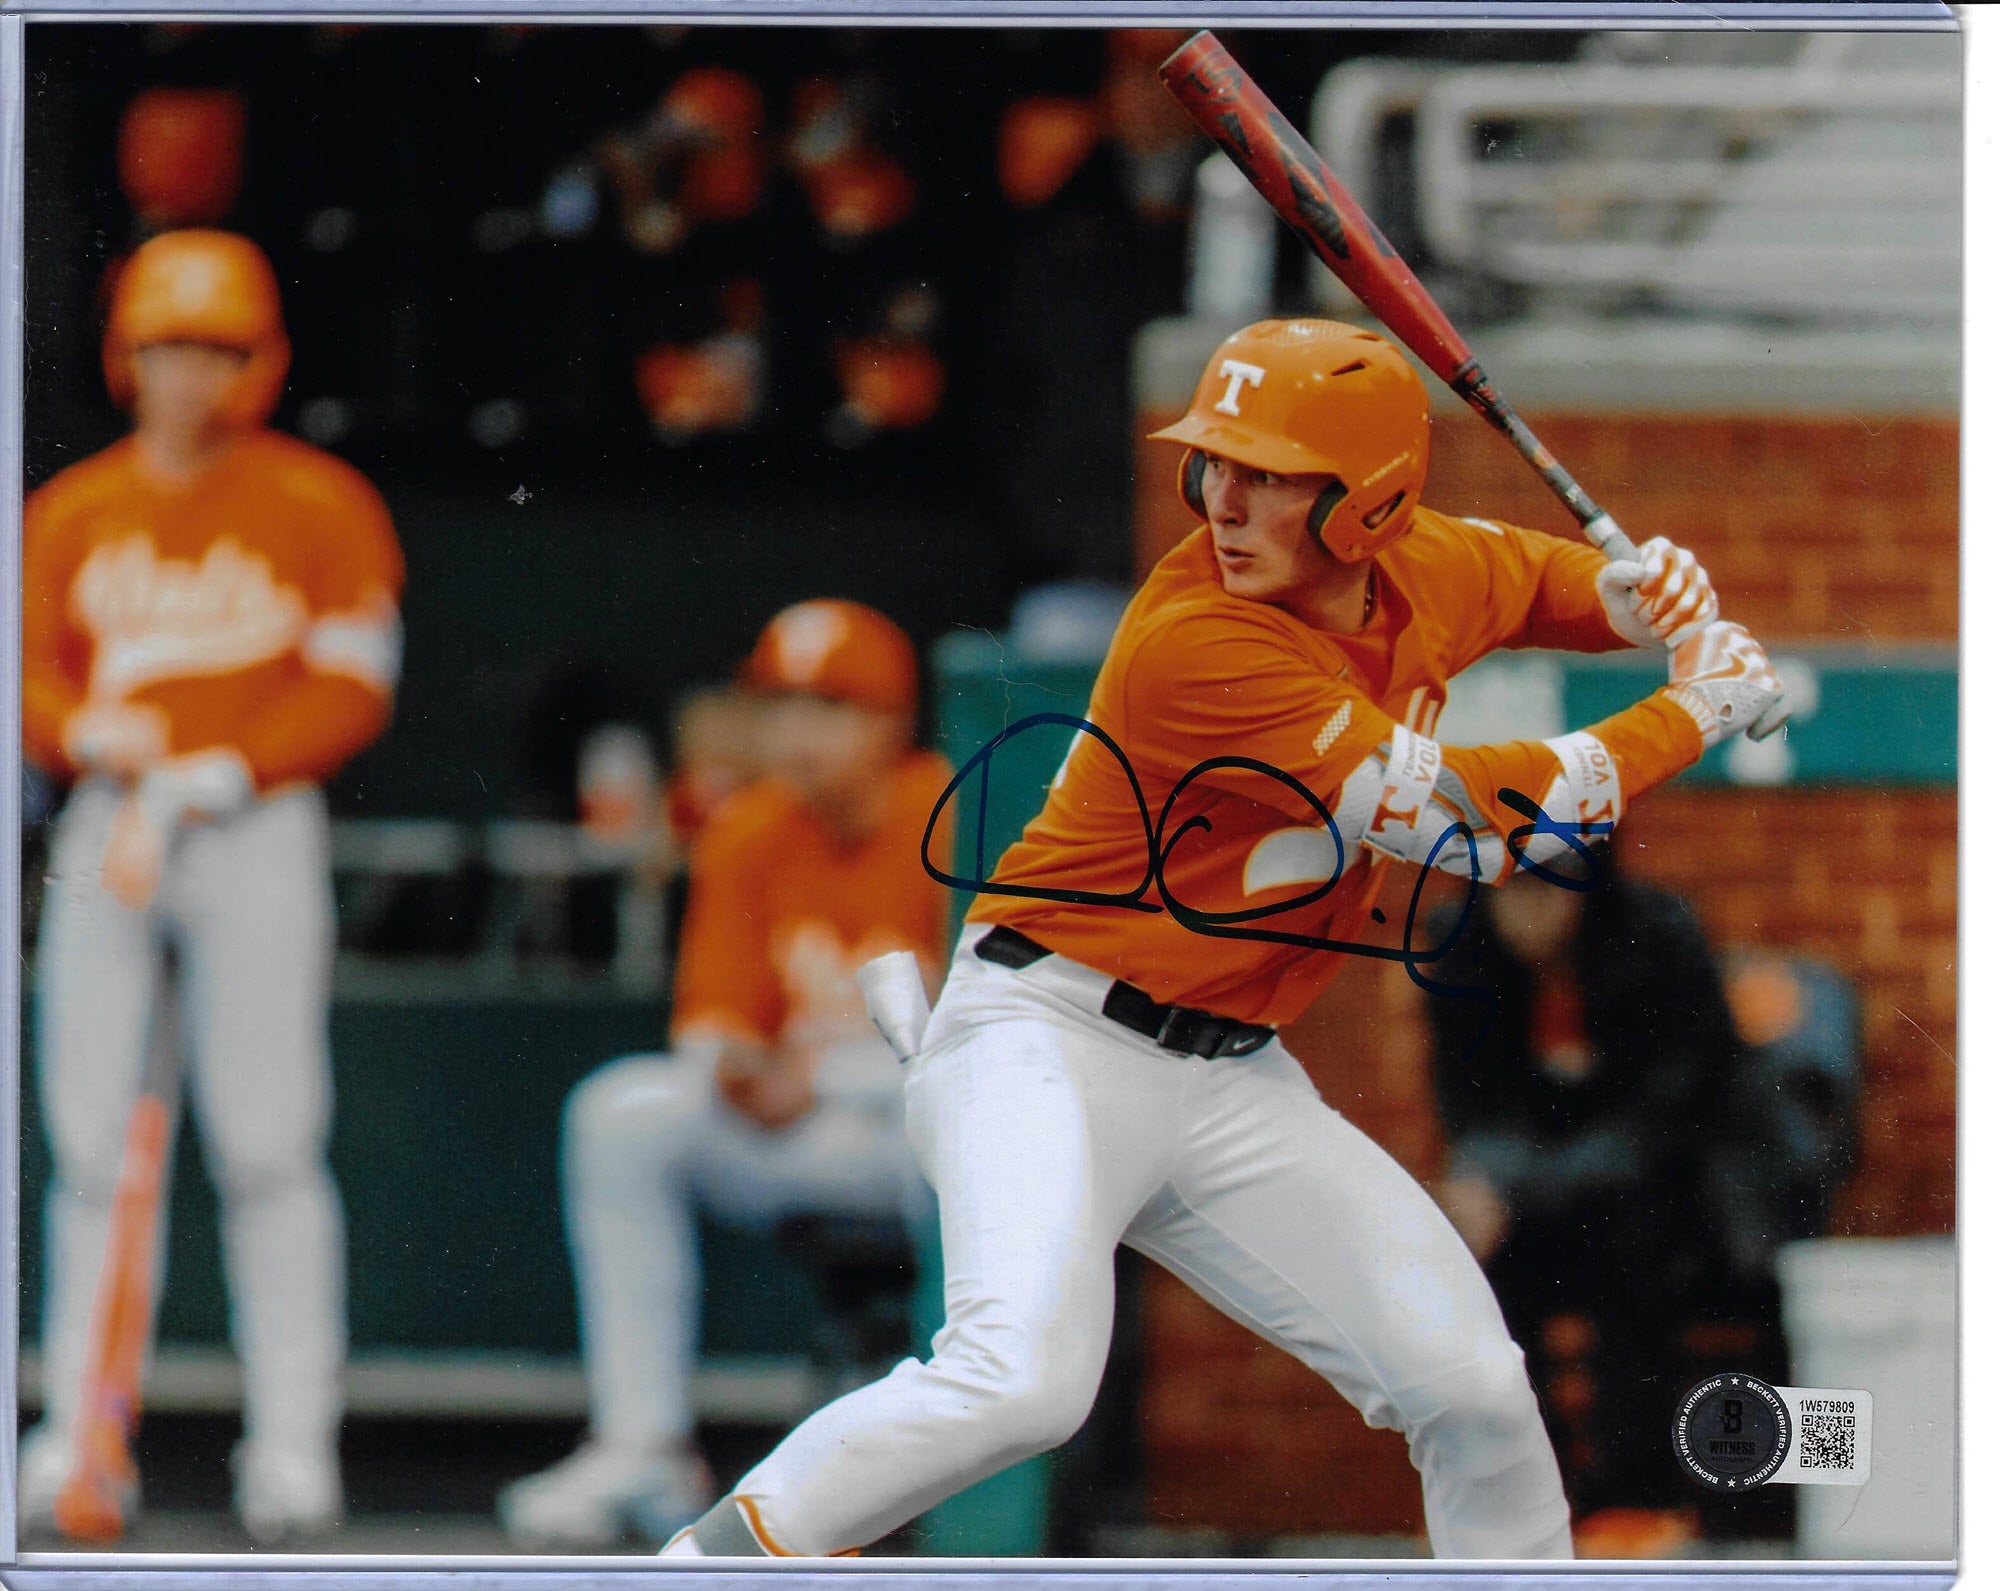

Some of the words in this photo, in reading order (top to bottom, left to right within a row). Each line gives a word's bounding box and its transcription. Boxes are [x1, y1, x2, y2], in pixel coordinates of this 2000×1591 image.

[1214, 359, 1266, 417] T
[1370, 785, 1419, 832] T
[1683, 1379, 1722, 1415] AUTHENTIC
[1747, 1381, 1780, 1408] BECKETT
[1799, 1400, 1855, 1413] 1W579809
[1678, 1415, 1690, 1456] VERIFIED
[1776, 1408, 1787, 1449] VERIFIED
[1709, 1440, 1756, 1455] WITNESS
[1686, 1456, 1719, 1485] BECKETT
[1743, 1449, 1782, 1486] AUTHENTIC
